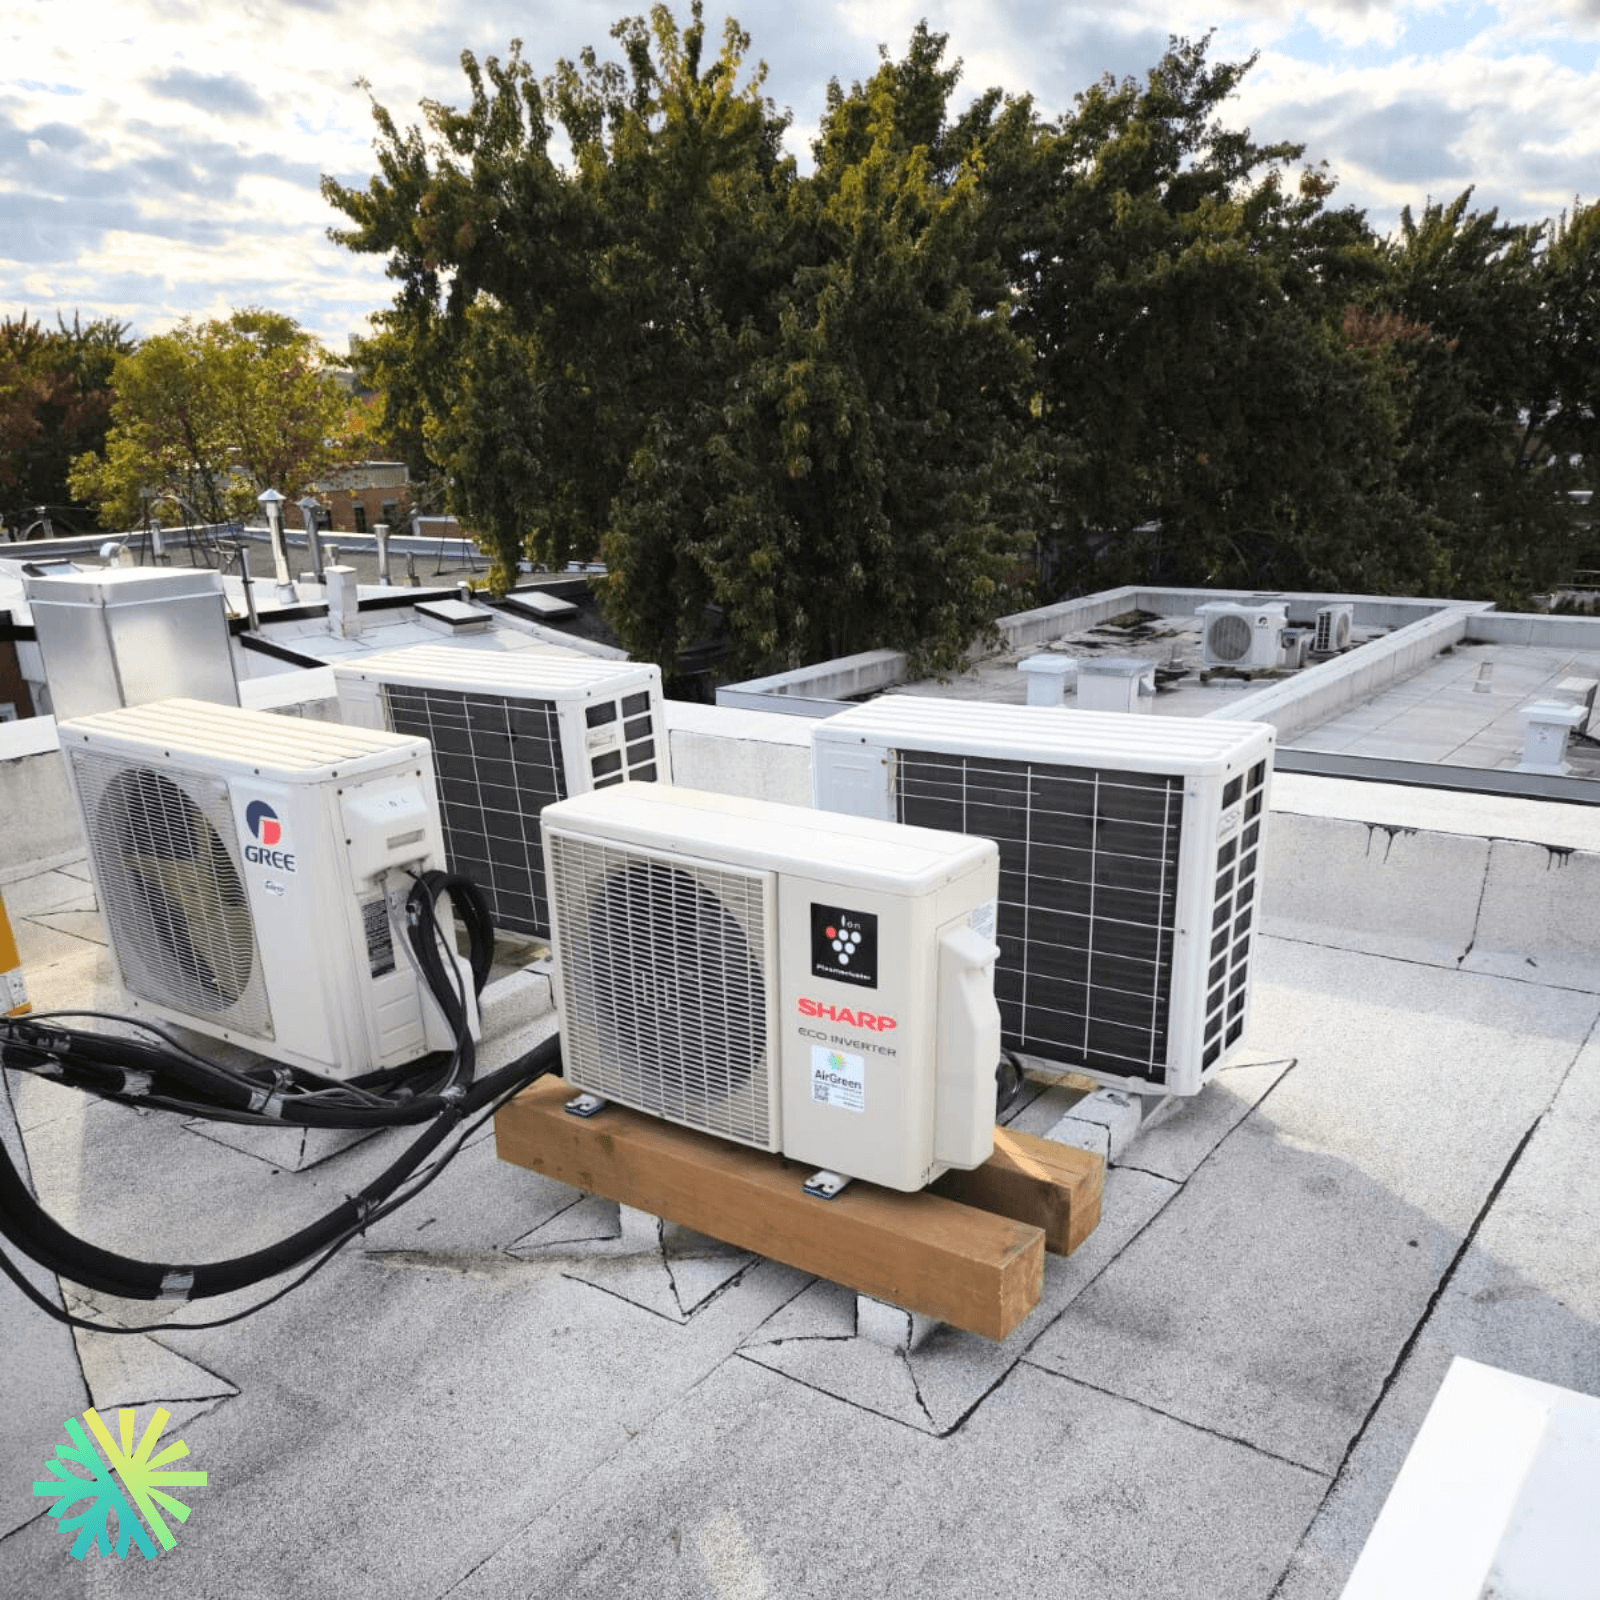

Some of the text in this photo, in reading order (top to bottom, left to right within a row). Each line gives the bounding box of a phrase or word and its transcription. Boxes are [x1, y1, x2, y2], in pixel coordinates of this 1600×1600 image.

[245, 845, 296, 872] GREE
[797, 998, 897, 1032] SHARP
[830, 1035, 897, 1058] INVERTER
[815, 1069, 863, 1090] AirGreen
